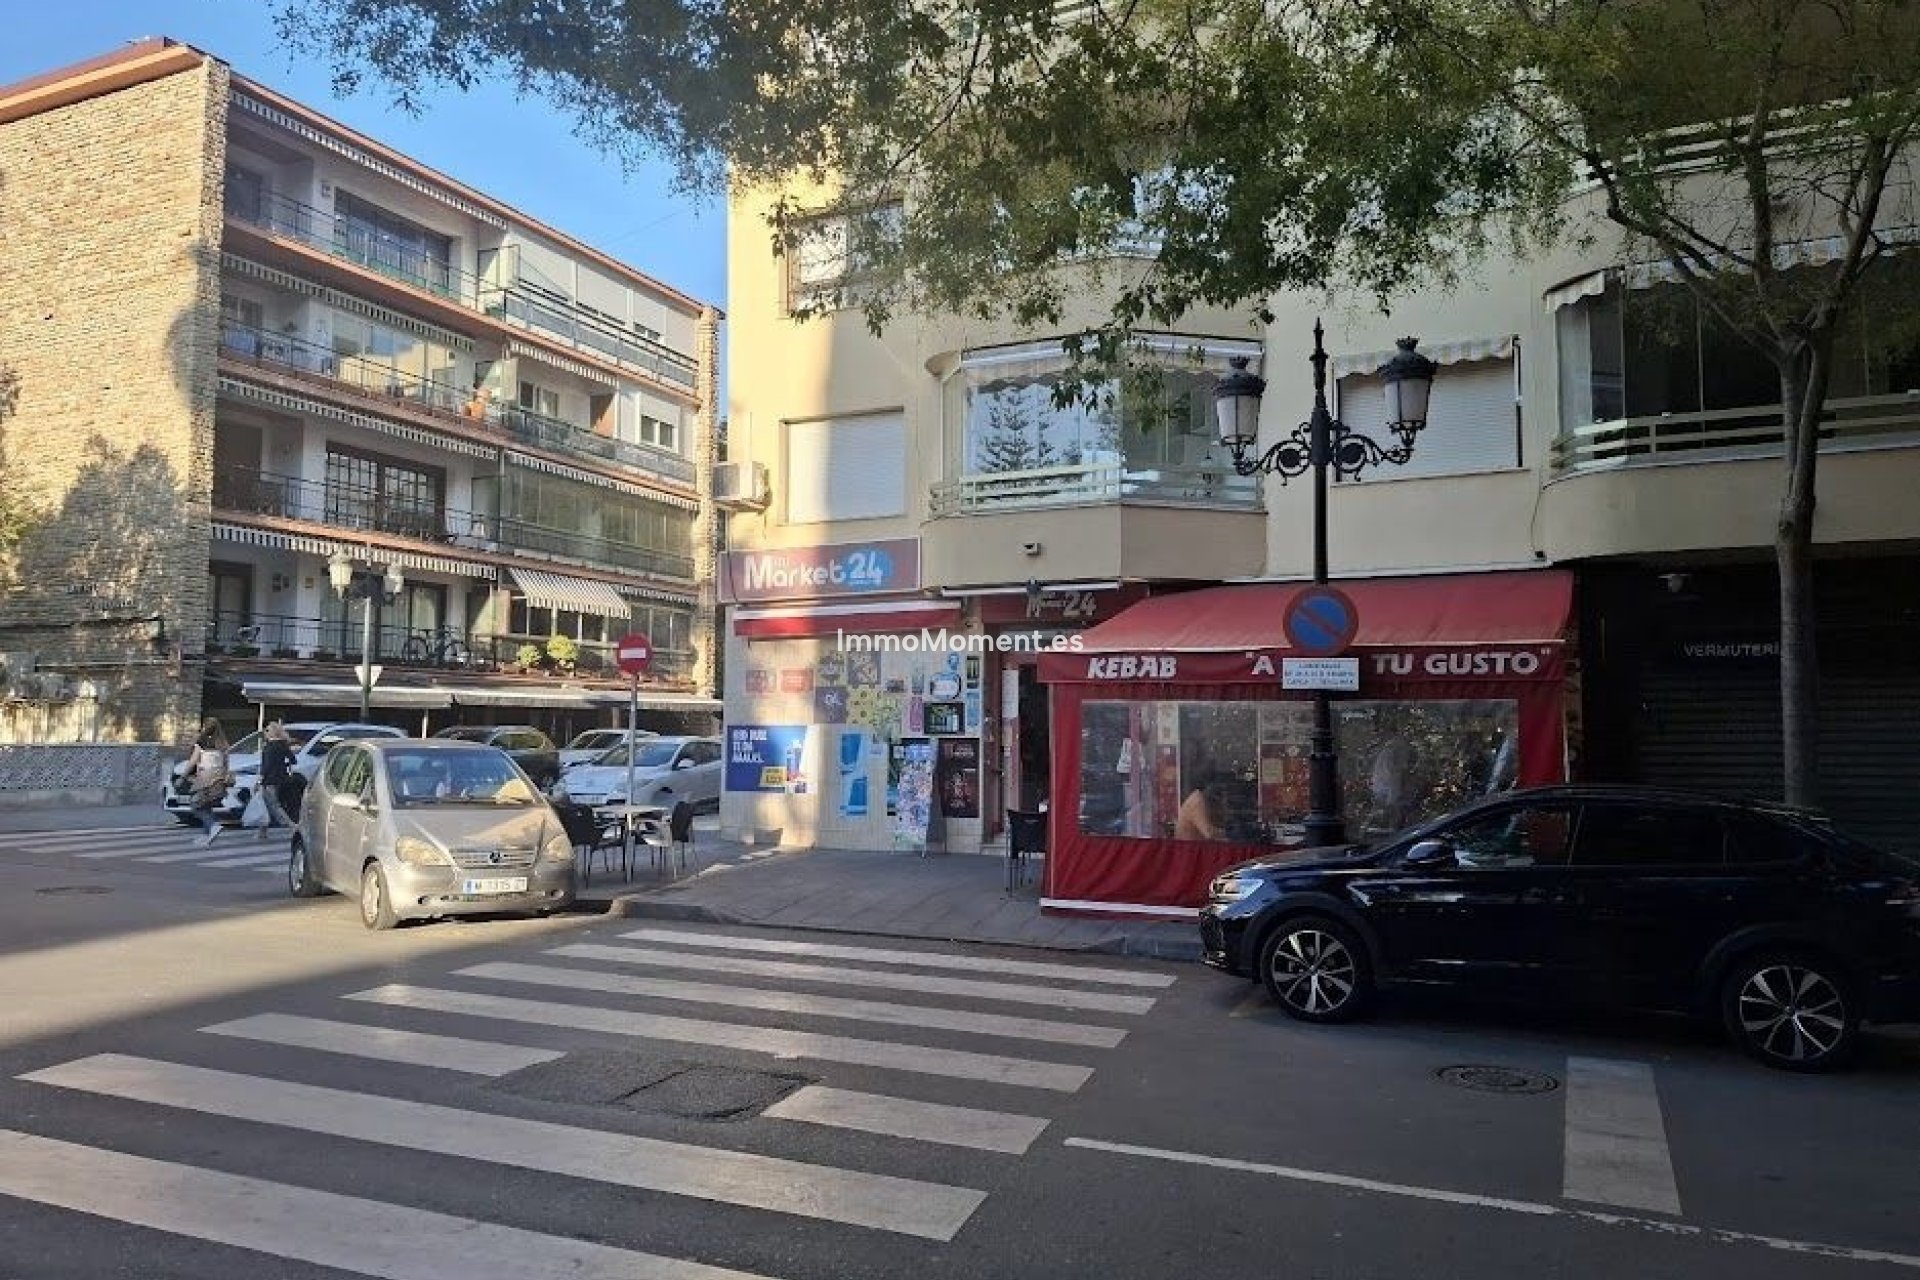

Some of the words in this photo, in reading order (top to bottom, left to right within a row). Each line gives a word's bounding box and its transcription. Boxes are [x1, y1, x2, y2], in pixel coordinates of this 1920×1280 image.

[744, 554, 847, 590] Market
[848, 551, 884, 586] 24
[1683, 640, 1780, 657] VERMUTERI
[1087, 655, 1177, 680] KEBAB
[1371, 653, 1415, 675] TU
